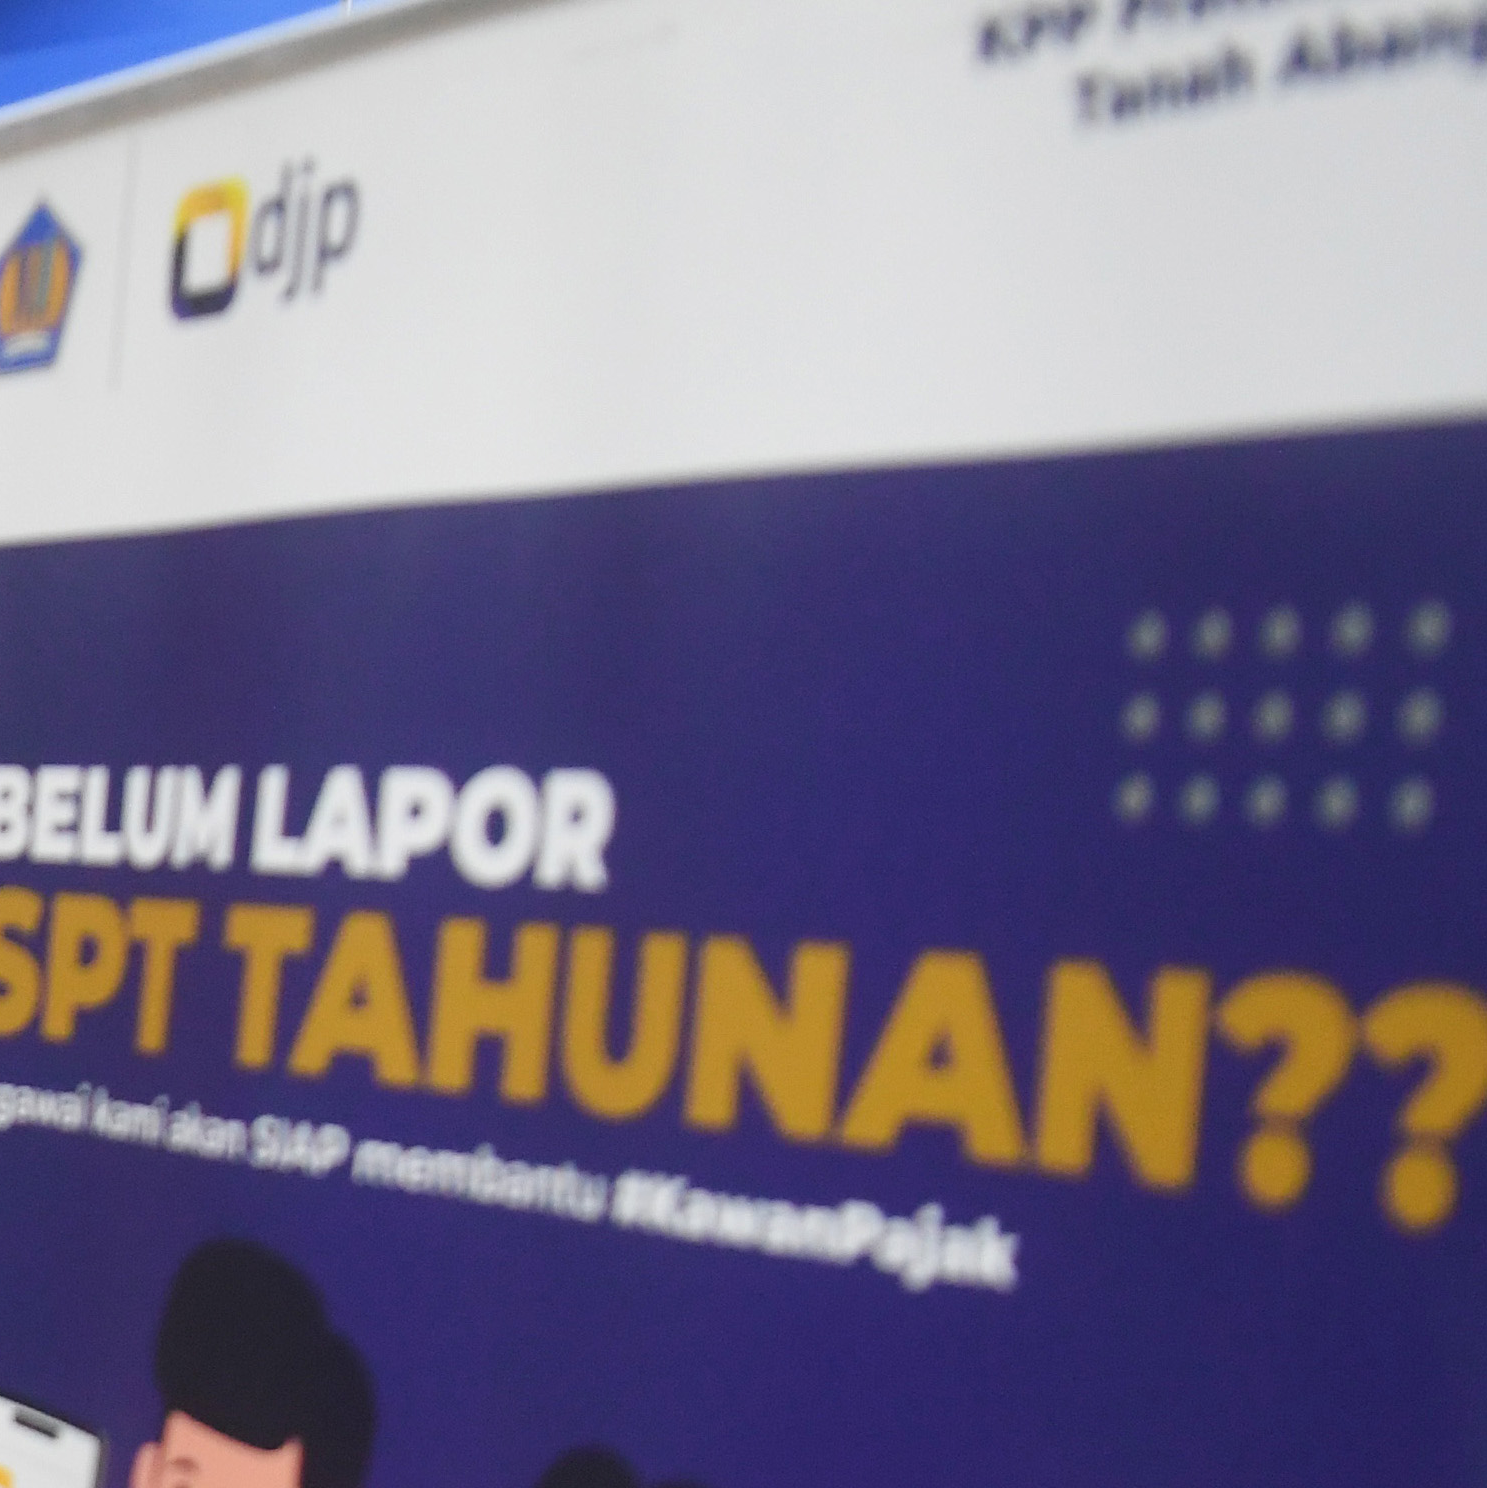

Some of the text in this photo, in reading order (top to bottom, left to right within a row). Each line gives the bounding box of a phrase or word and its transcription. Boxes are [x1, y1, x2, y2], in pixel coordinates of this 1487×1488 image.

[248, 763, 616, 892] LAPOR
[248, 1114, 351, 1178] SIAP
[350, 1138, 608, 1223] membantu
